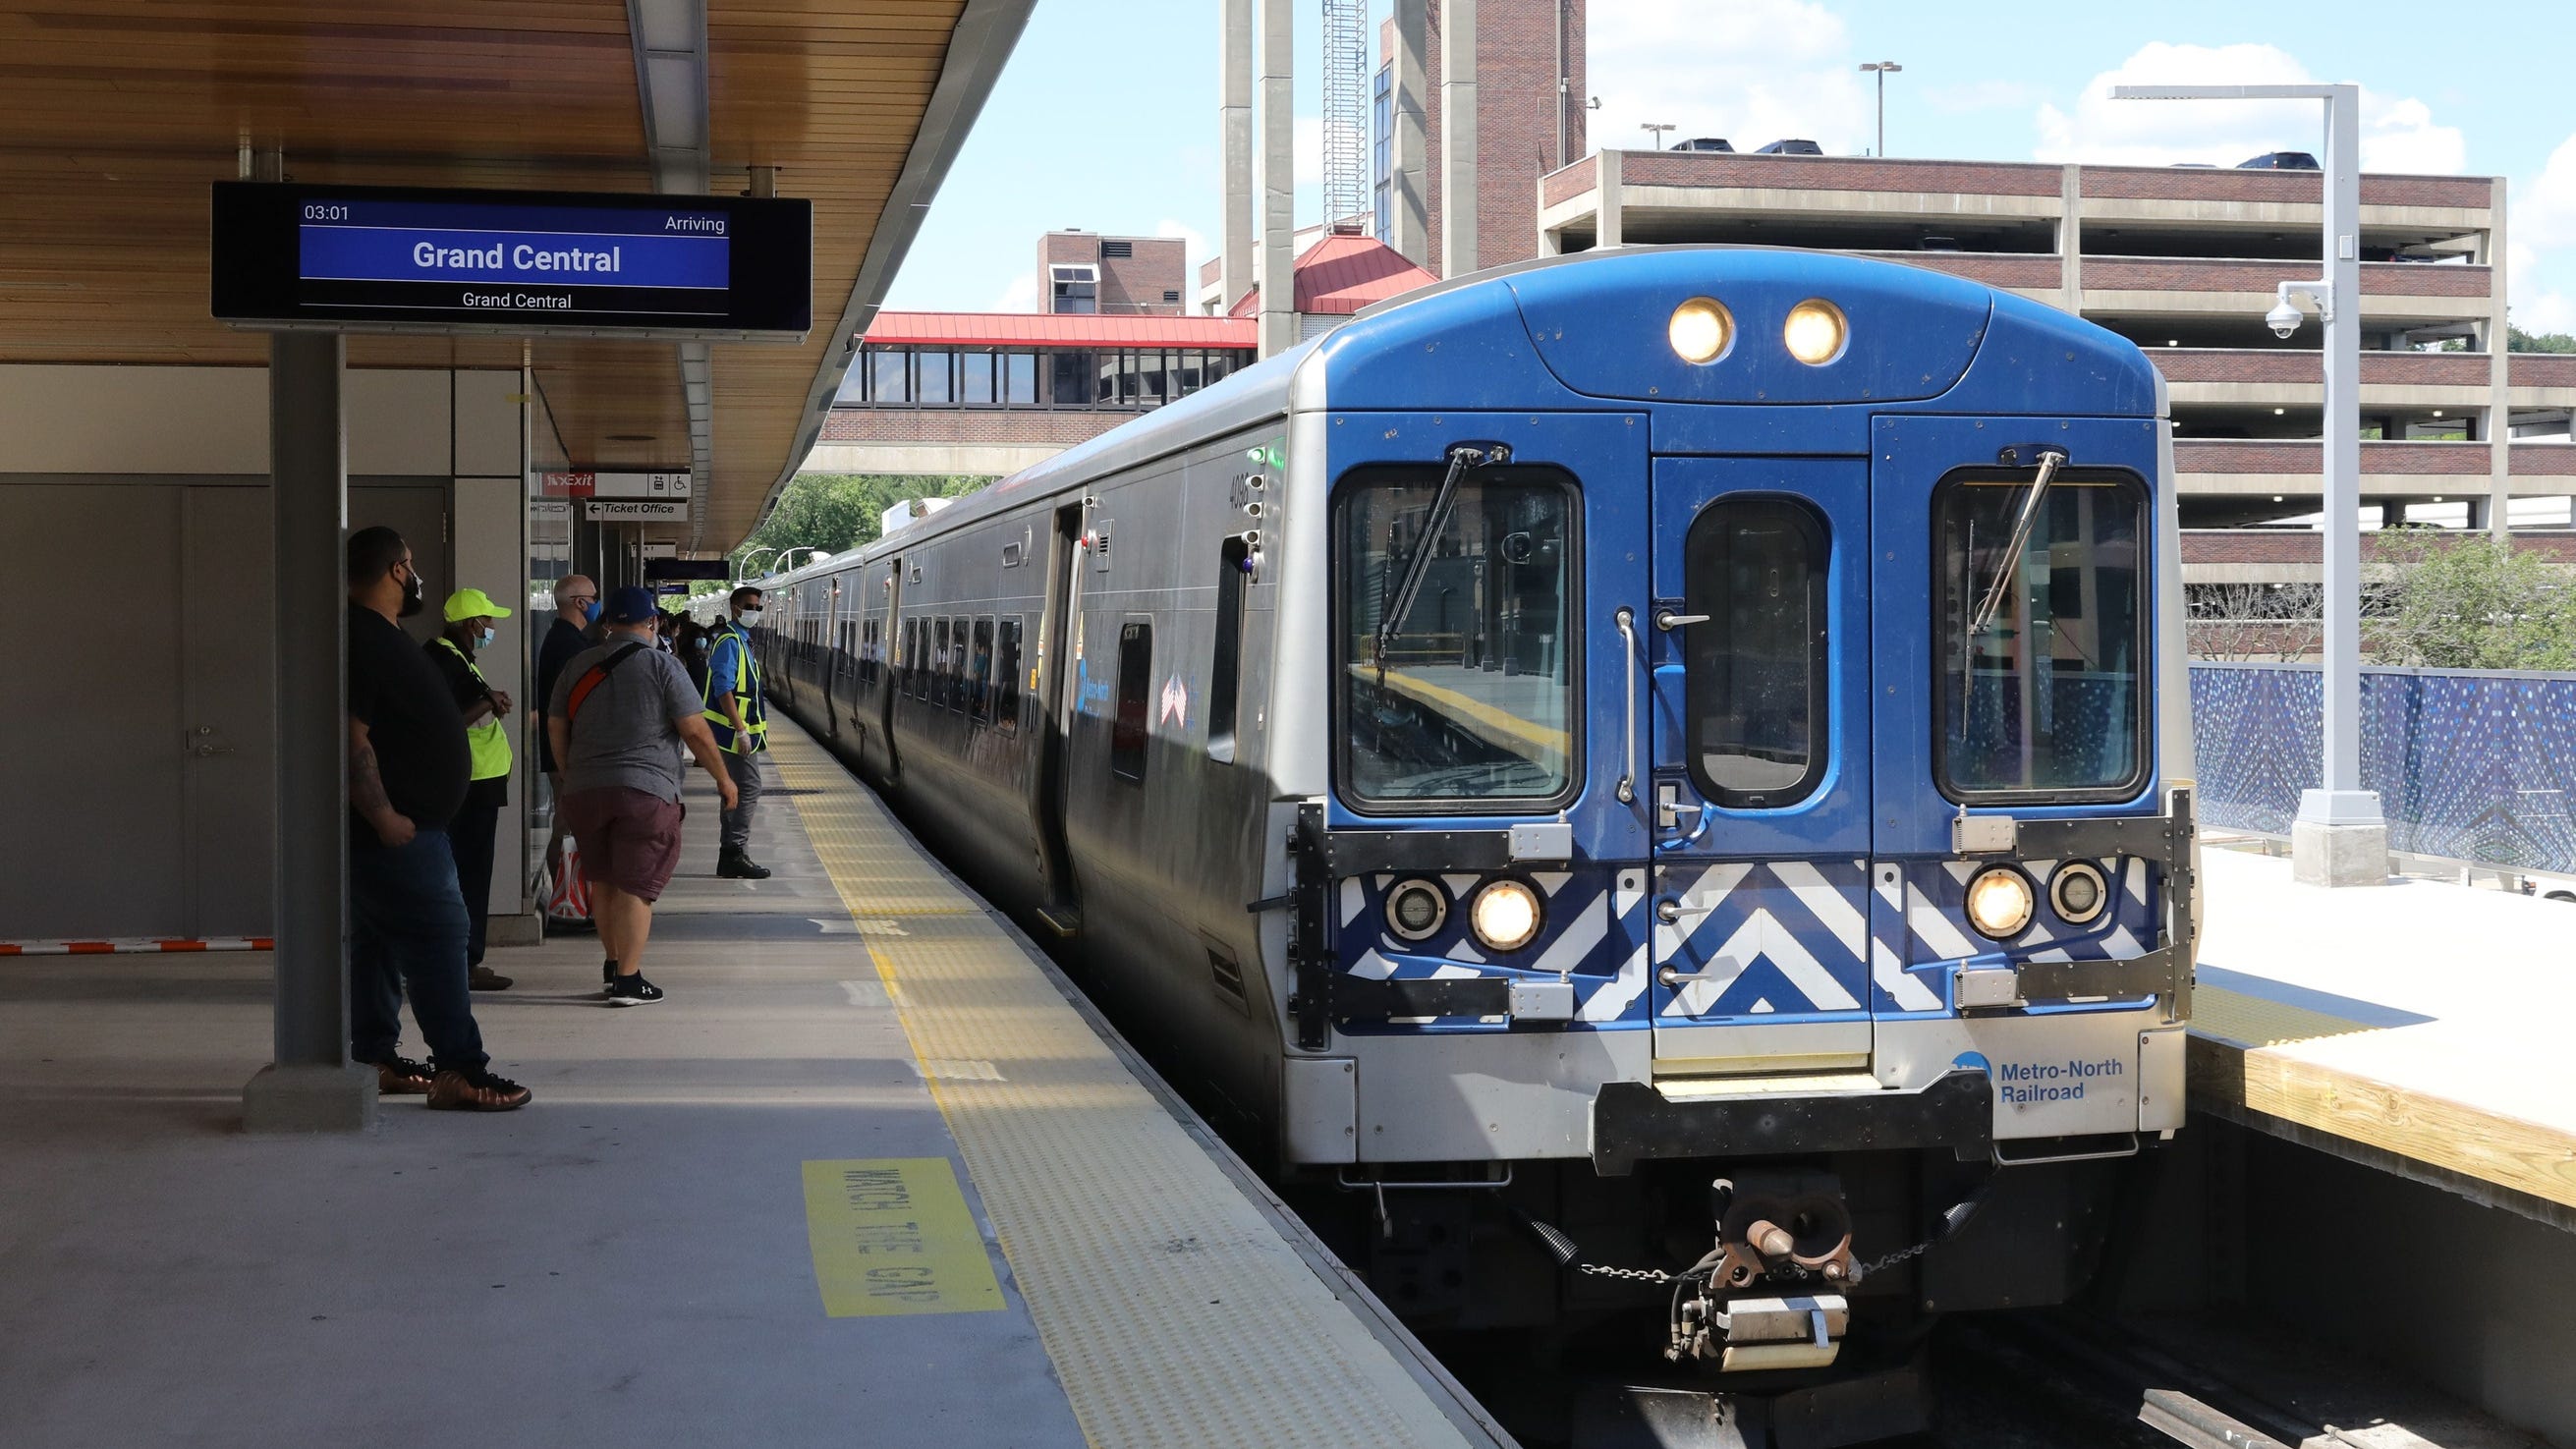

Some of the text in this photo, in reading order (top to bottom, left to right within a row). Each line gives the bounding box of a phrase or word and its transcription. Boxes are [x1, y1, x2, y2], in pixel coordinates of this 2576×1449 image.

[304, 204, 726, 235] 03:01 Arriving
[413, 241, 621, 273] Grand Central
[462, 290, 572, 309] Grand Central
[567, 474, 593, 486] Exit
[604, 503, 675, 514] Ticket Office
[2000, 1058, 2123, 1081] Metro-North
[2000, 1083, 2085, 1103] Railroad
[843, 1169, 940, 1303] WATCH THE GAP
